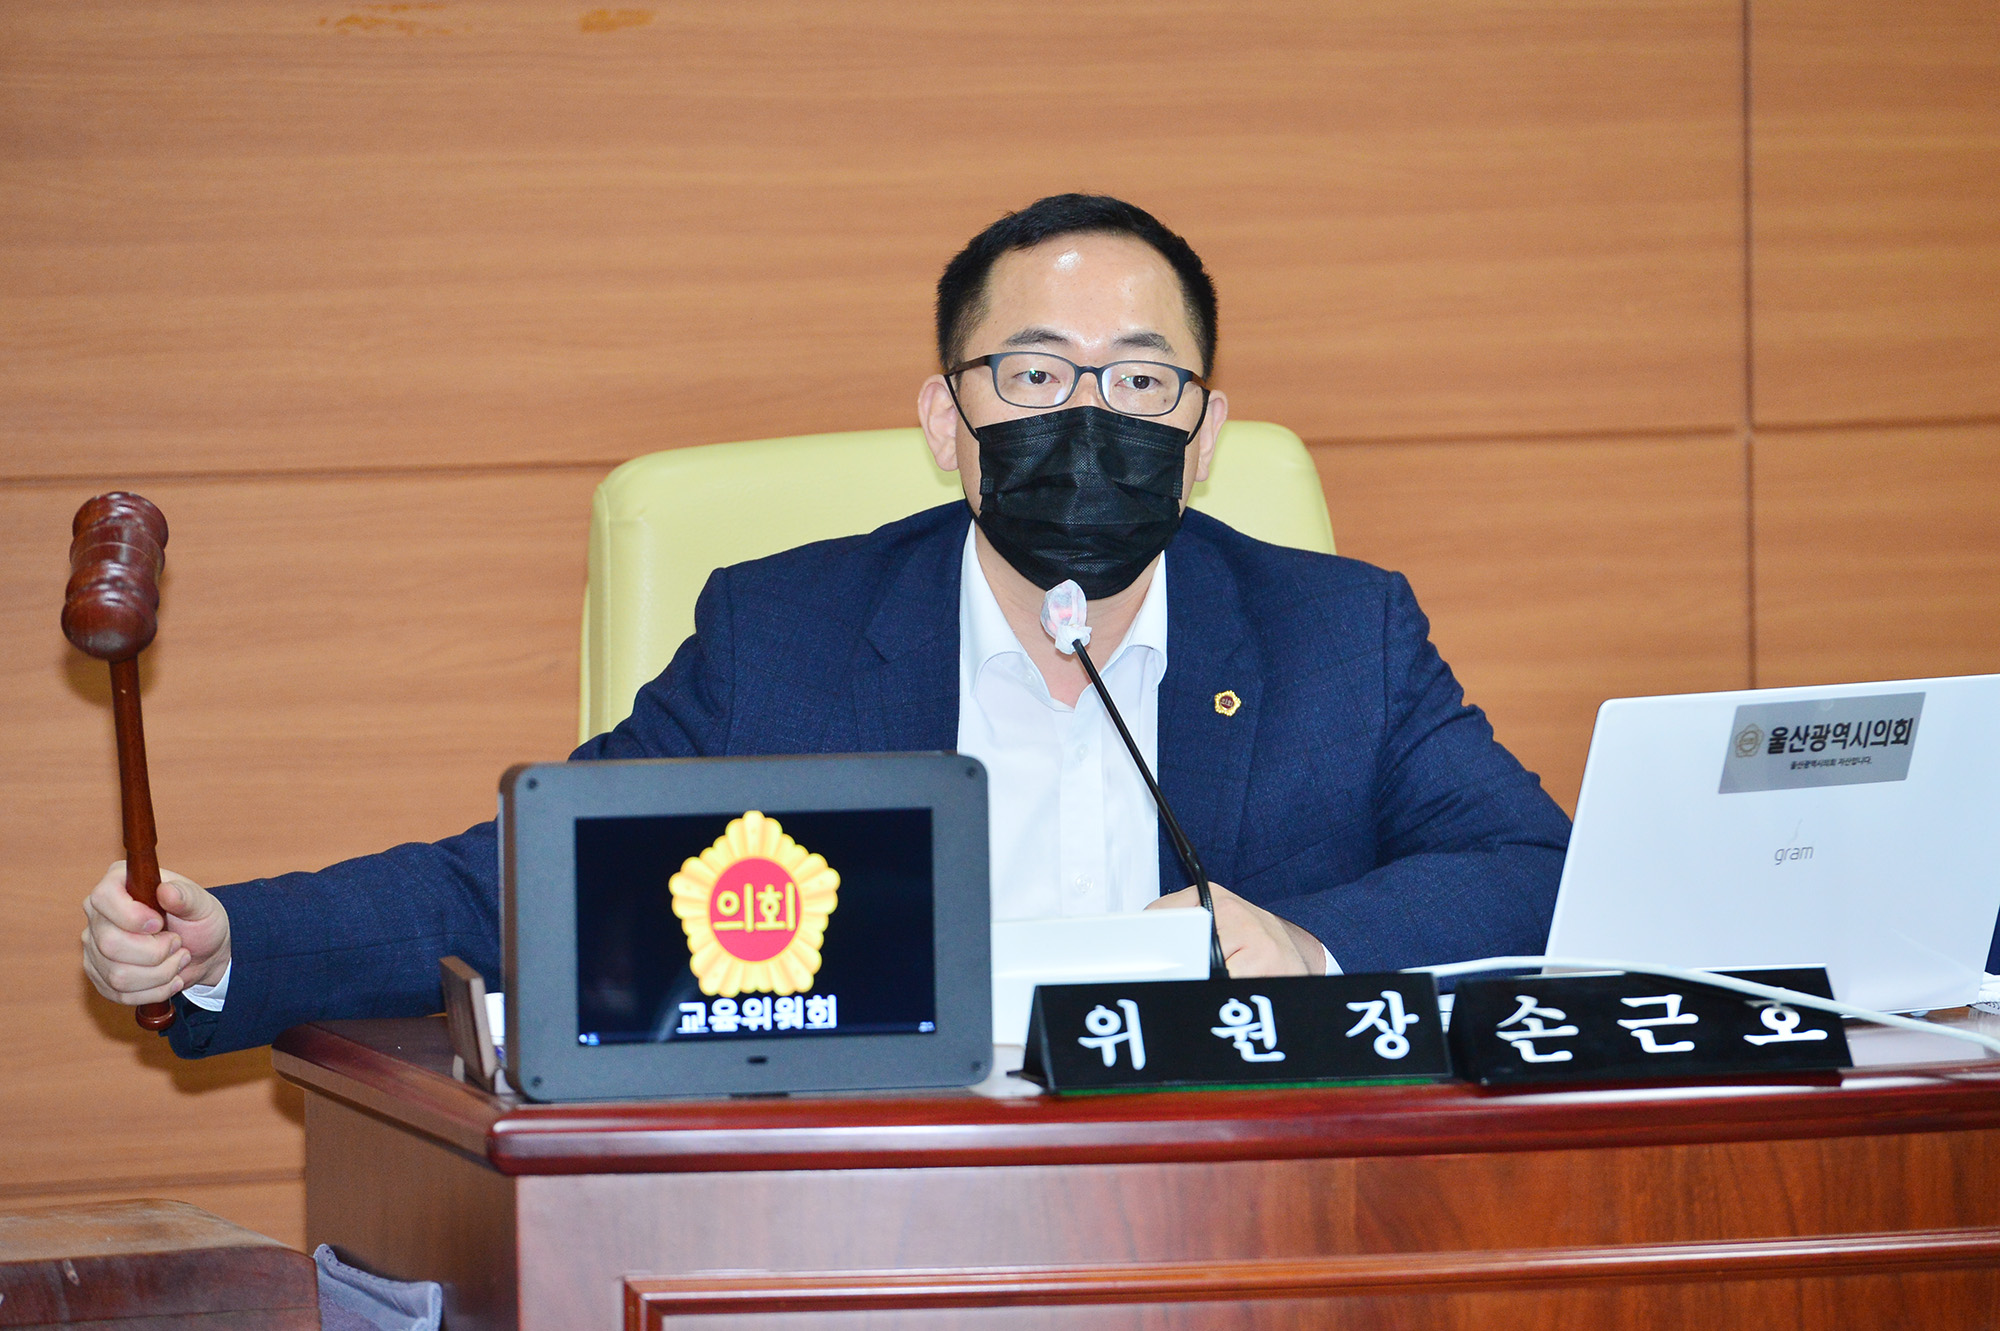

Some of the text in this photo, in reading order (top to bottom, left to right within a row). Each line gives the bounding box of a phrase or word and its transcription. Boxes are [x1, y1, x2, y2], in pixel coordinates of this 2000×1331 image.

[1767, 717, 1914, 755] 울산광역시의회
[1774, 846, 1814, 865] gram
[712, 882, 796, 932] 의회
[675, 994, 838, 1034] 교육위원회
